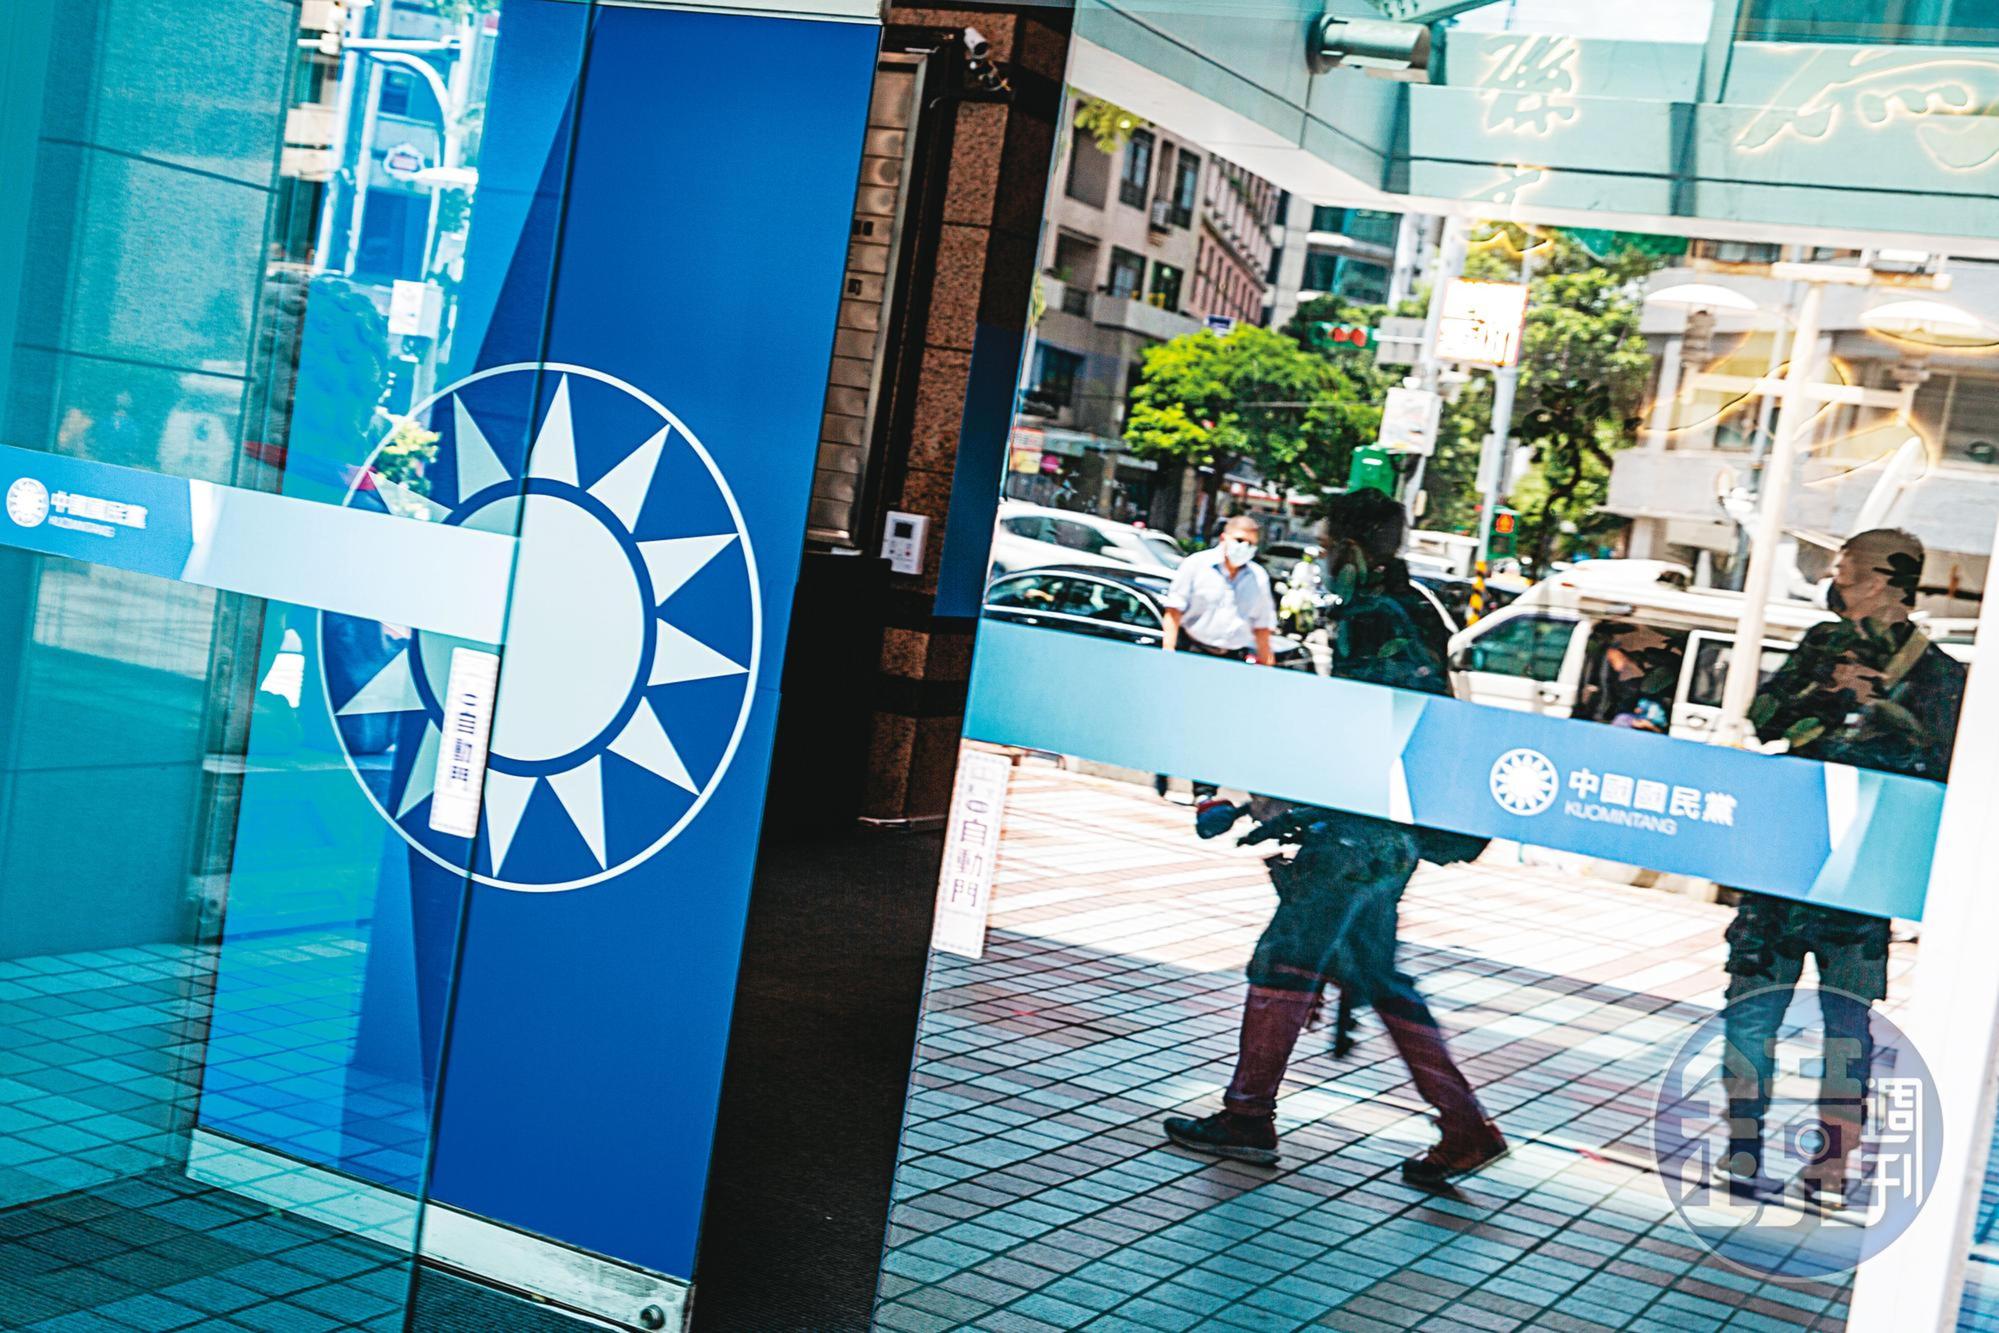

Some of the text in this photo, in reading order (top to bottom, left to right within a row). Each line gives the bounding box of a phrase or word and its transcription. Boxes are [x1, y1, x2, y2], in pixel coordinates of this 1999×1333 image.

[1564, 800, 1678, 836] KUOMINTANG
[1568, 767, 1738, 827] 中國國民黨
